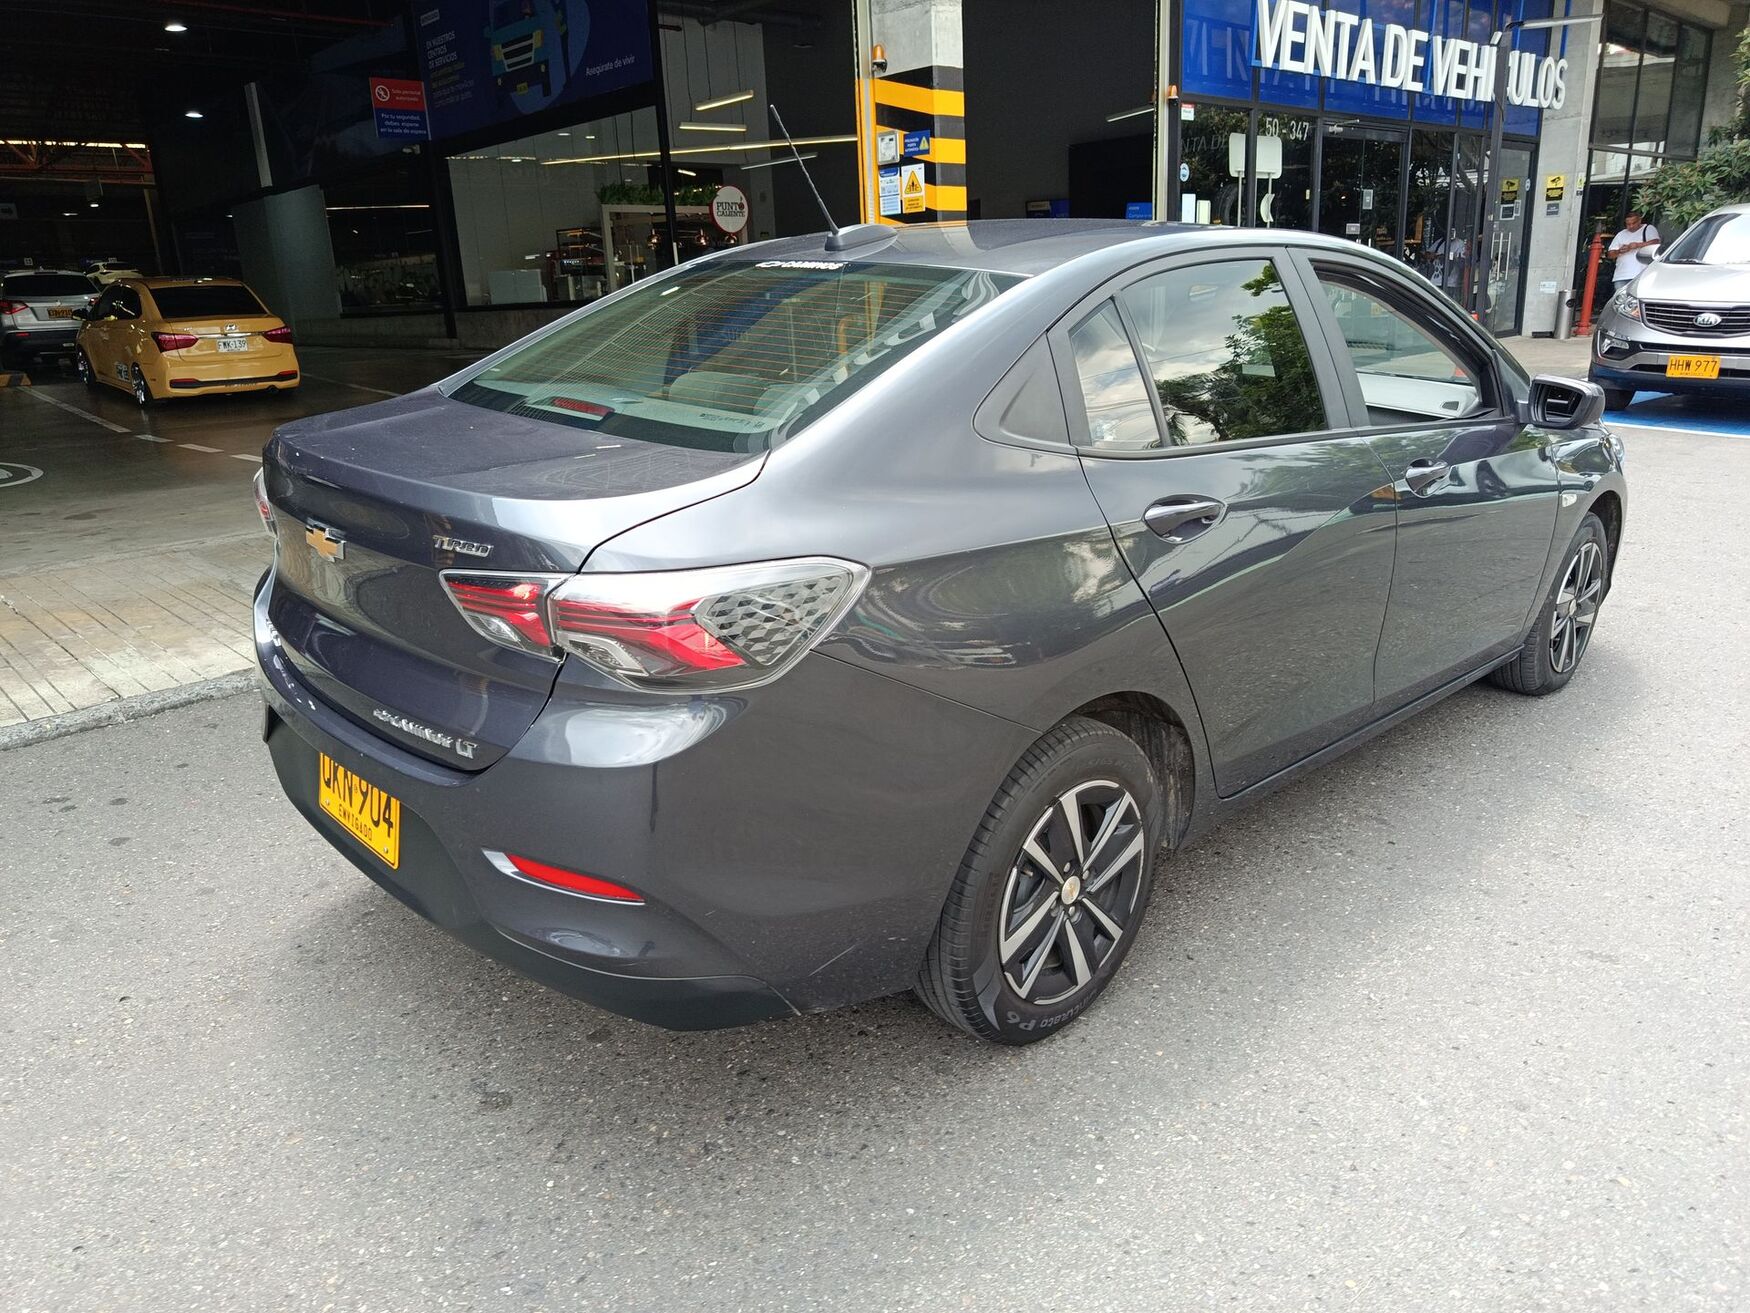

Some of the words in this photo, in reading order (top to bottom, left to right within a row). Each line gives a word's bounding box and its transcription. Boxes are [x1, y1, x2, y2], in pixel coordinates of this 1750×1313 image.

[1257, 0, 1376, 84] VENTA
[1381, 23, 1428, 92] DE
[1432, 31, 1568, 110] VEHÍULOS
[1265, 117, 1279, 137] 50
[1289, 120, 1310, 141] 347
[1695, 315, 1718, 326] KIA
[1695, 360, 1718, 372] 977
